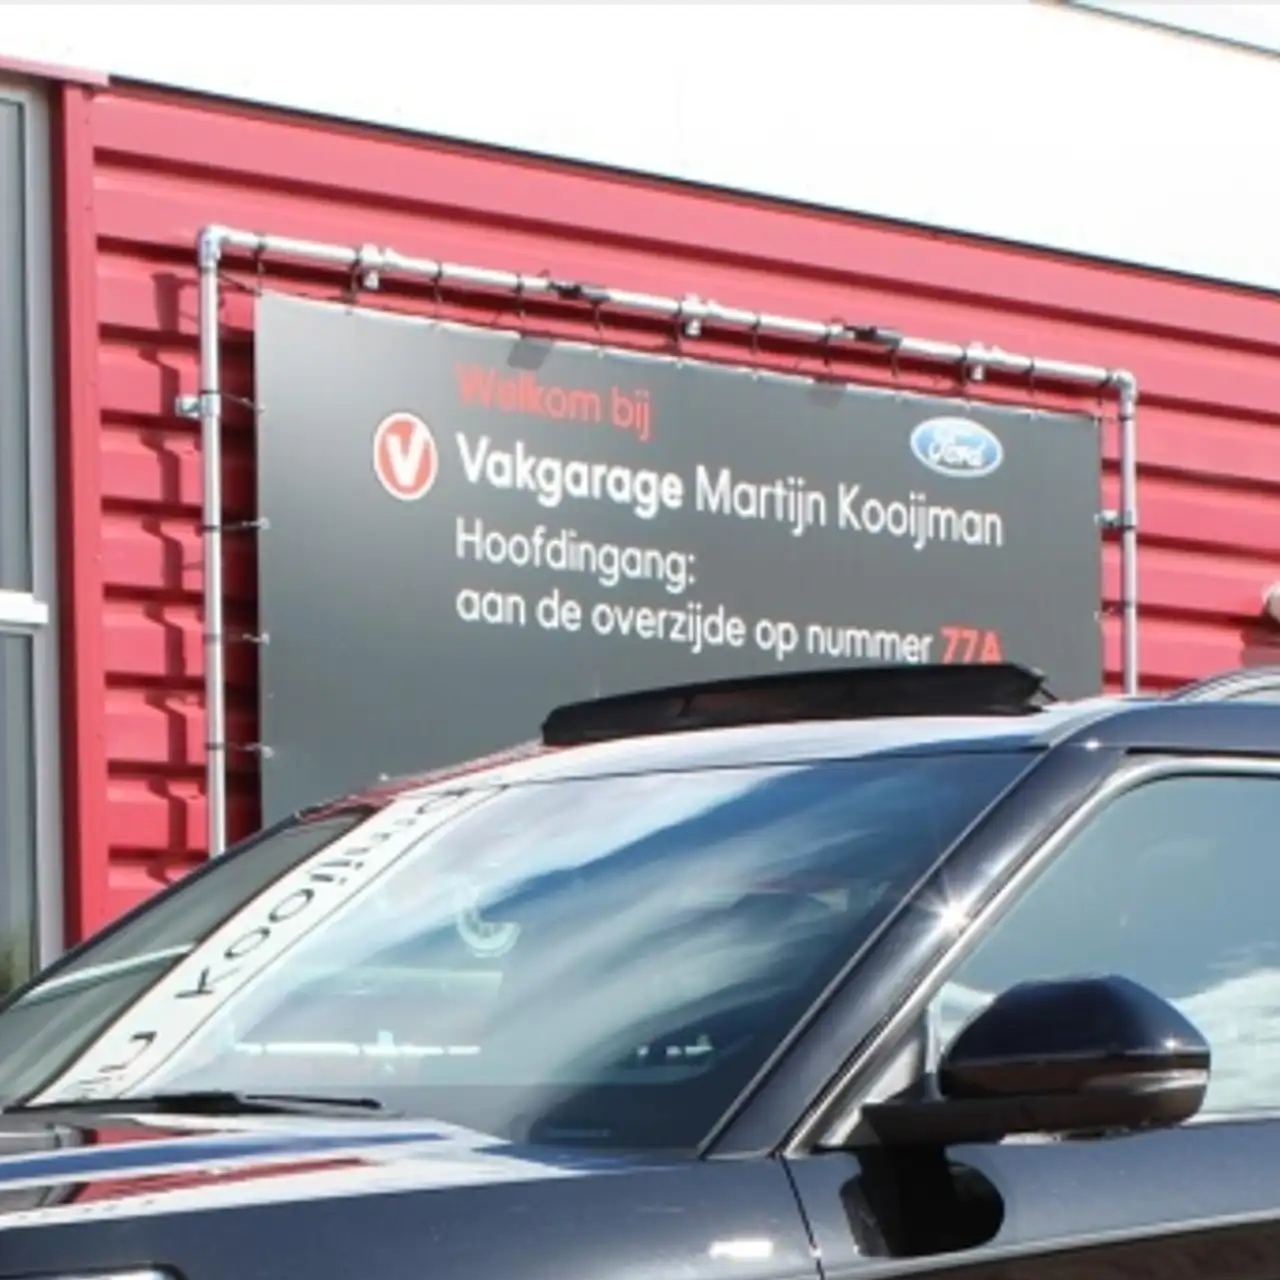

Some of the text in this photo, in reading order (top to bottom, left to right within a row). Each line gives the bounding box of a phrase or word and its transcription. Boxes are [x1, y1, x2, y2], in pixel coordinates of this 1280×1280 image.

[454, 363, 652, 442] Welkom bij
[926, 425, 989, 469] Ford
[455, 431, 1004, 552] Vakgarage Martijn Kooijman
[455, 516, 696, 595] Hoofdingang:
[455, 587, 1004, 665] aan de overzijde op nummer 77A
